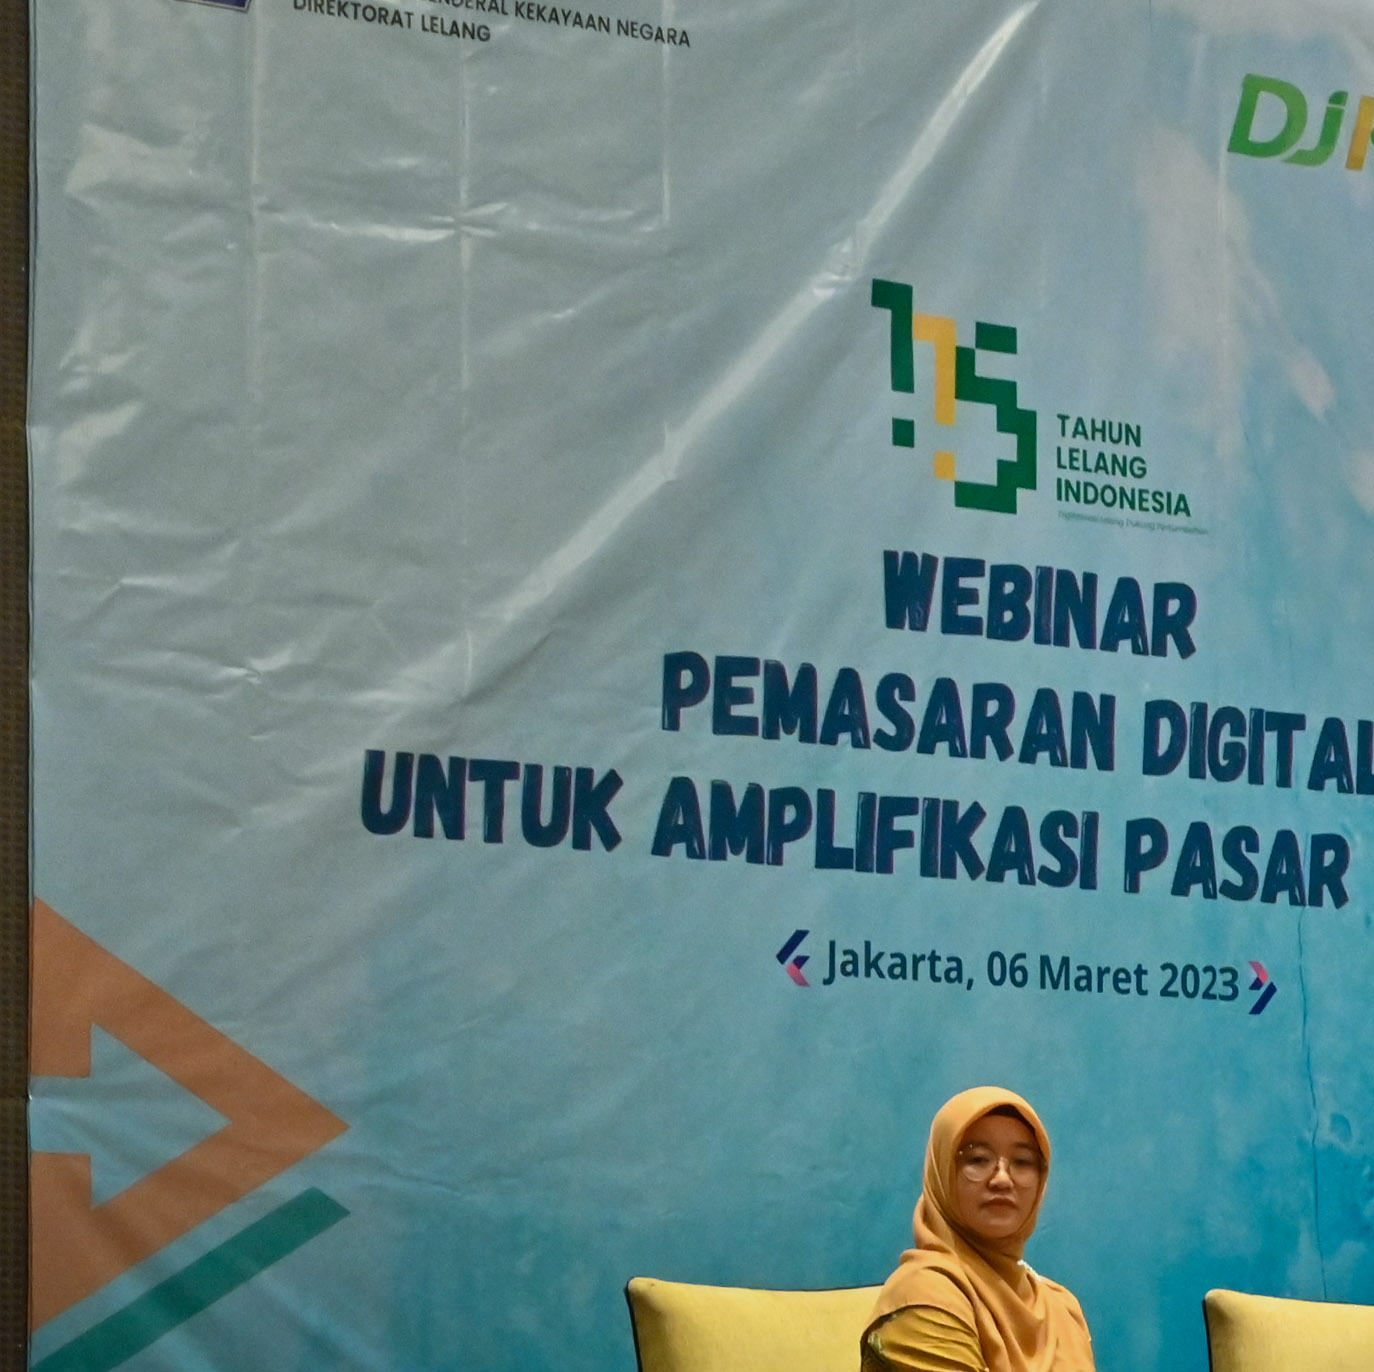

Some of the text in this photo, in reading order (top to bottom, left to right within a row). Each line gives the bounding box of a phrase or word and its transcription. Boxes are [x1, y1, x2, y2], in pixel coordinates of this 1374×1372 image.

[293, 0, 491, 42] DIREKTORAT LELANG
[428, 0, 691, 48] ERAL KEKAYAAN NEGARA
[1056, 413, 1142, 447] TAHUN
[1056, 446, 1148, 479] LELANG
[1056, 477, 1192, 517] INDONESIA
[883, 550, 1197, 660] WEBINAR
[662, 651, 1116, 772] PEMASARAN
[361, 749, 624, 853] UNTUK
[651, 776, 1100, 891] AMPLIFIKASI
[1124, 817, 1350, 910] PASAR
[823, 939, 1240, 1002] Jakarta, 06 Maret 2023
